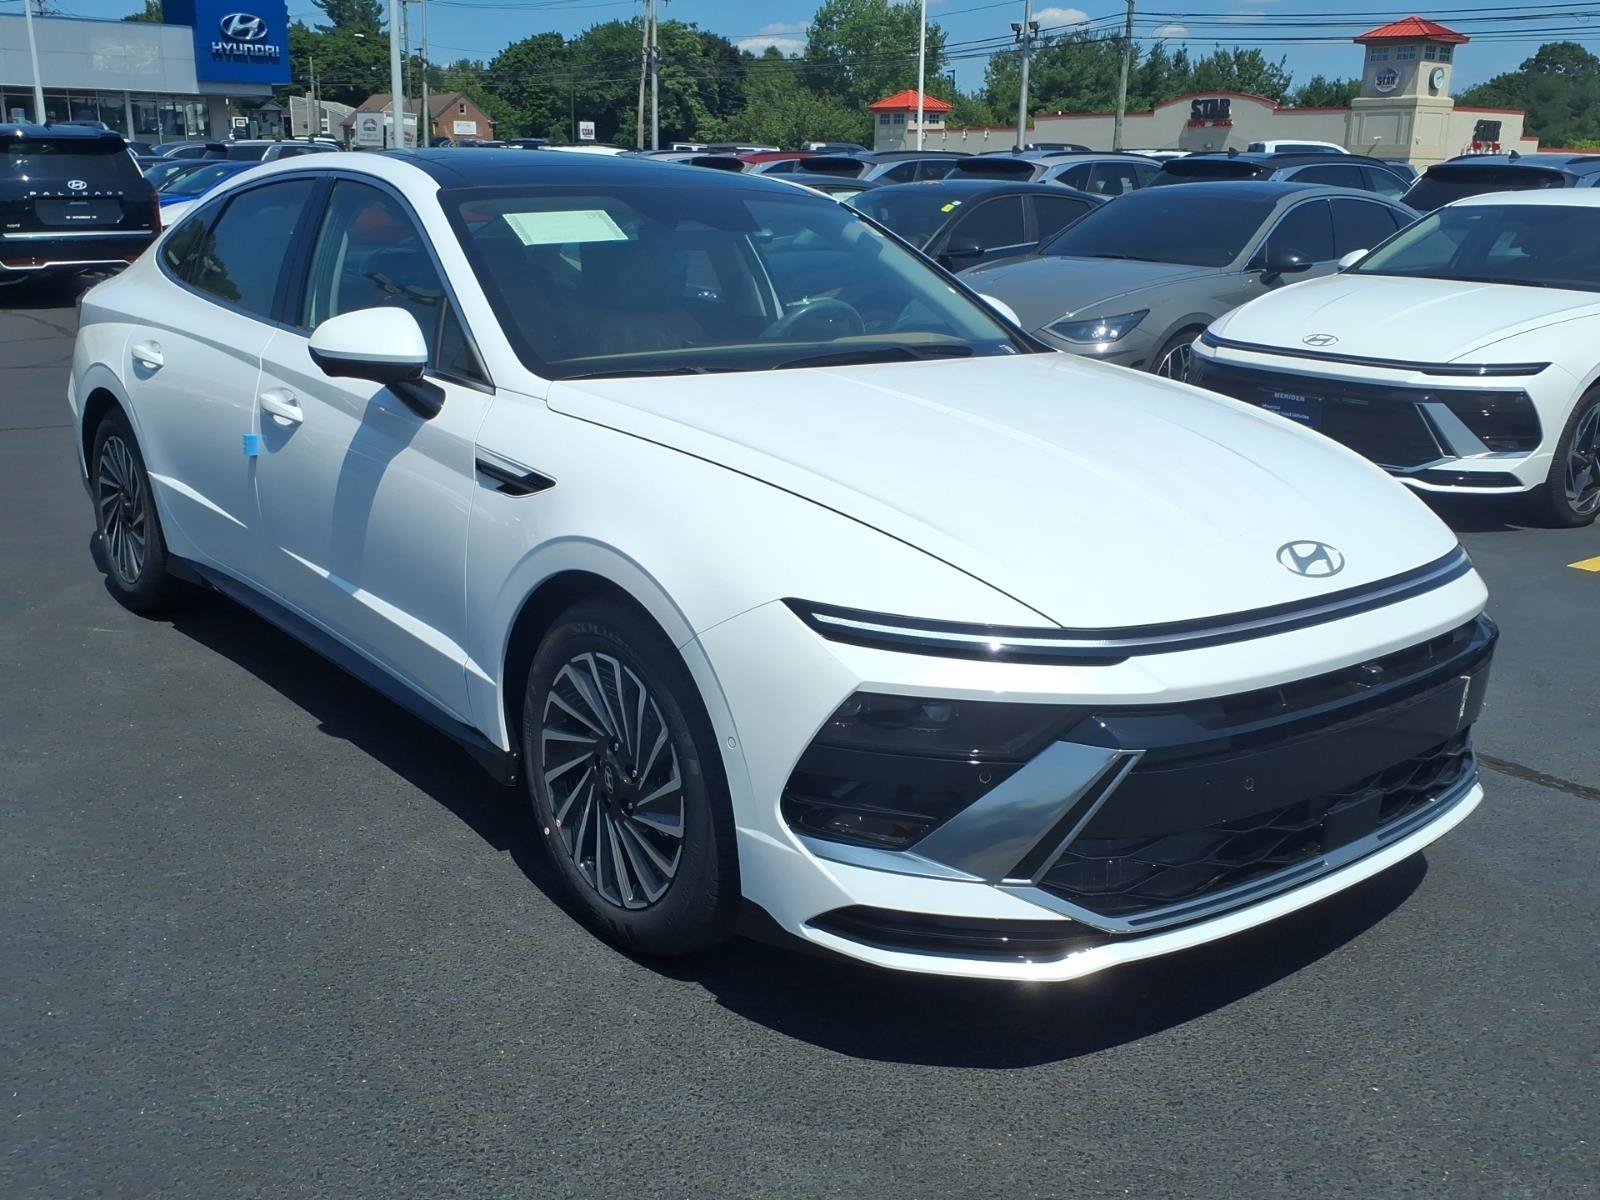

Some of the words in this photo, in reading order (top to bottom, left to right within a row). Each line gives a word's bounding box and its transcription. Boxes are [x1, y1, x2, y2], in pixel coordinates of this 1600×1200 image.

[211, 41, 280, 57] HYUNDAI
[1376, 75, 1396, 86] STAR
[1190, 98, 1231, 120] STAR
[1274, 391, 1305, 402] MERIDEN
